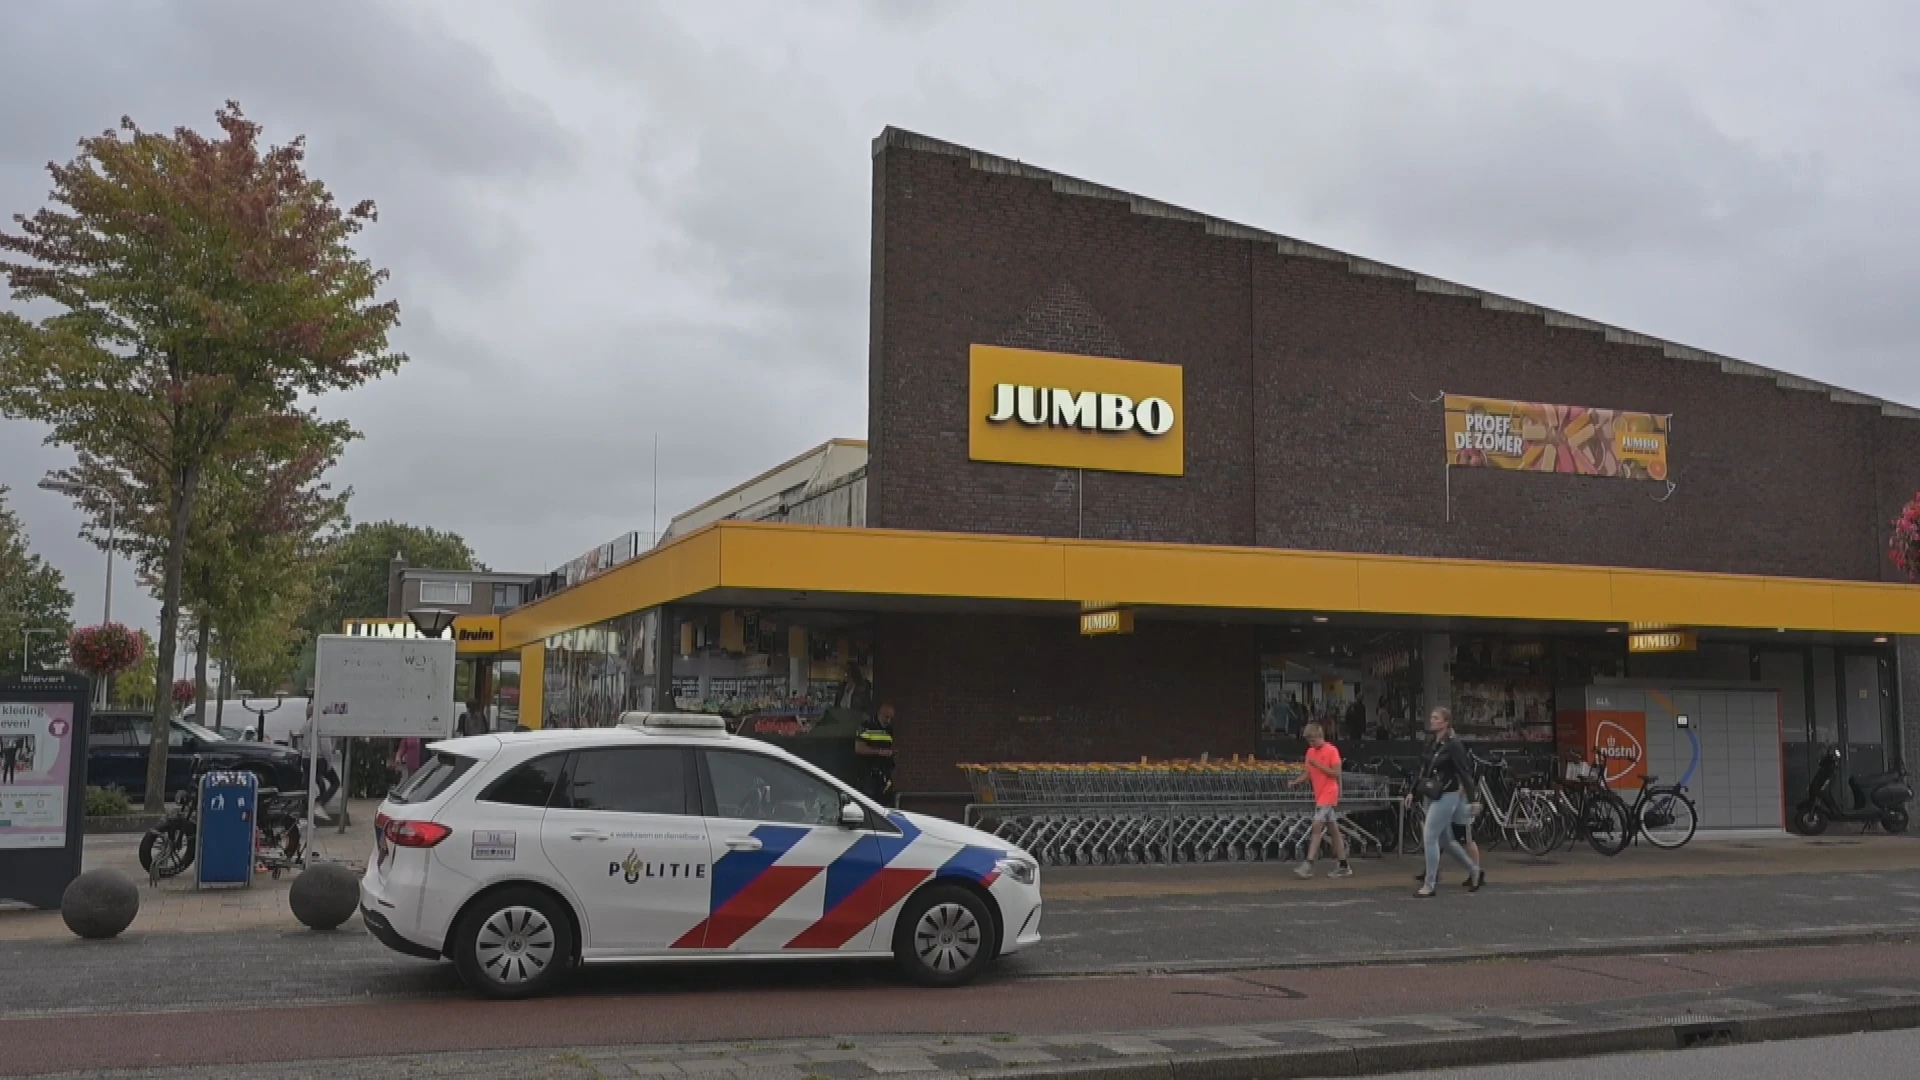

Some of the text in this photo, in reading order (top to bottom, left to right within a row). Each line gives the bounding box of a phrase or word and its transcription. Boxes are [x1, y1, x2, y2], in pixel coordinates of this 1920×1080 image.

[988, 383, 1175, 436] JUMBO
[1465, 412, 1512, 434] PROEF
[1455, 431, 1523, 455] DE ZOMER
[1083, 612, 1117, 631] JUMBO
[346, 623, 494, 641] JUM Bruins
[1631, 634, 1681, 649] JUMBO
[2, 705, 44, 718] kleding
[1600, 744, 1636, 762] postnl
[608, 861, 706, 885] POLITIE
